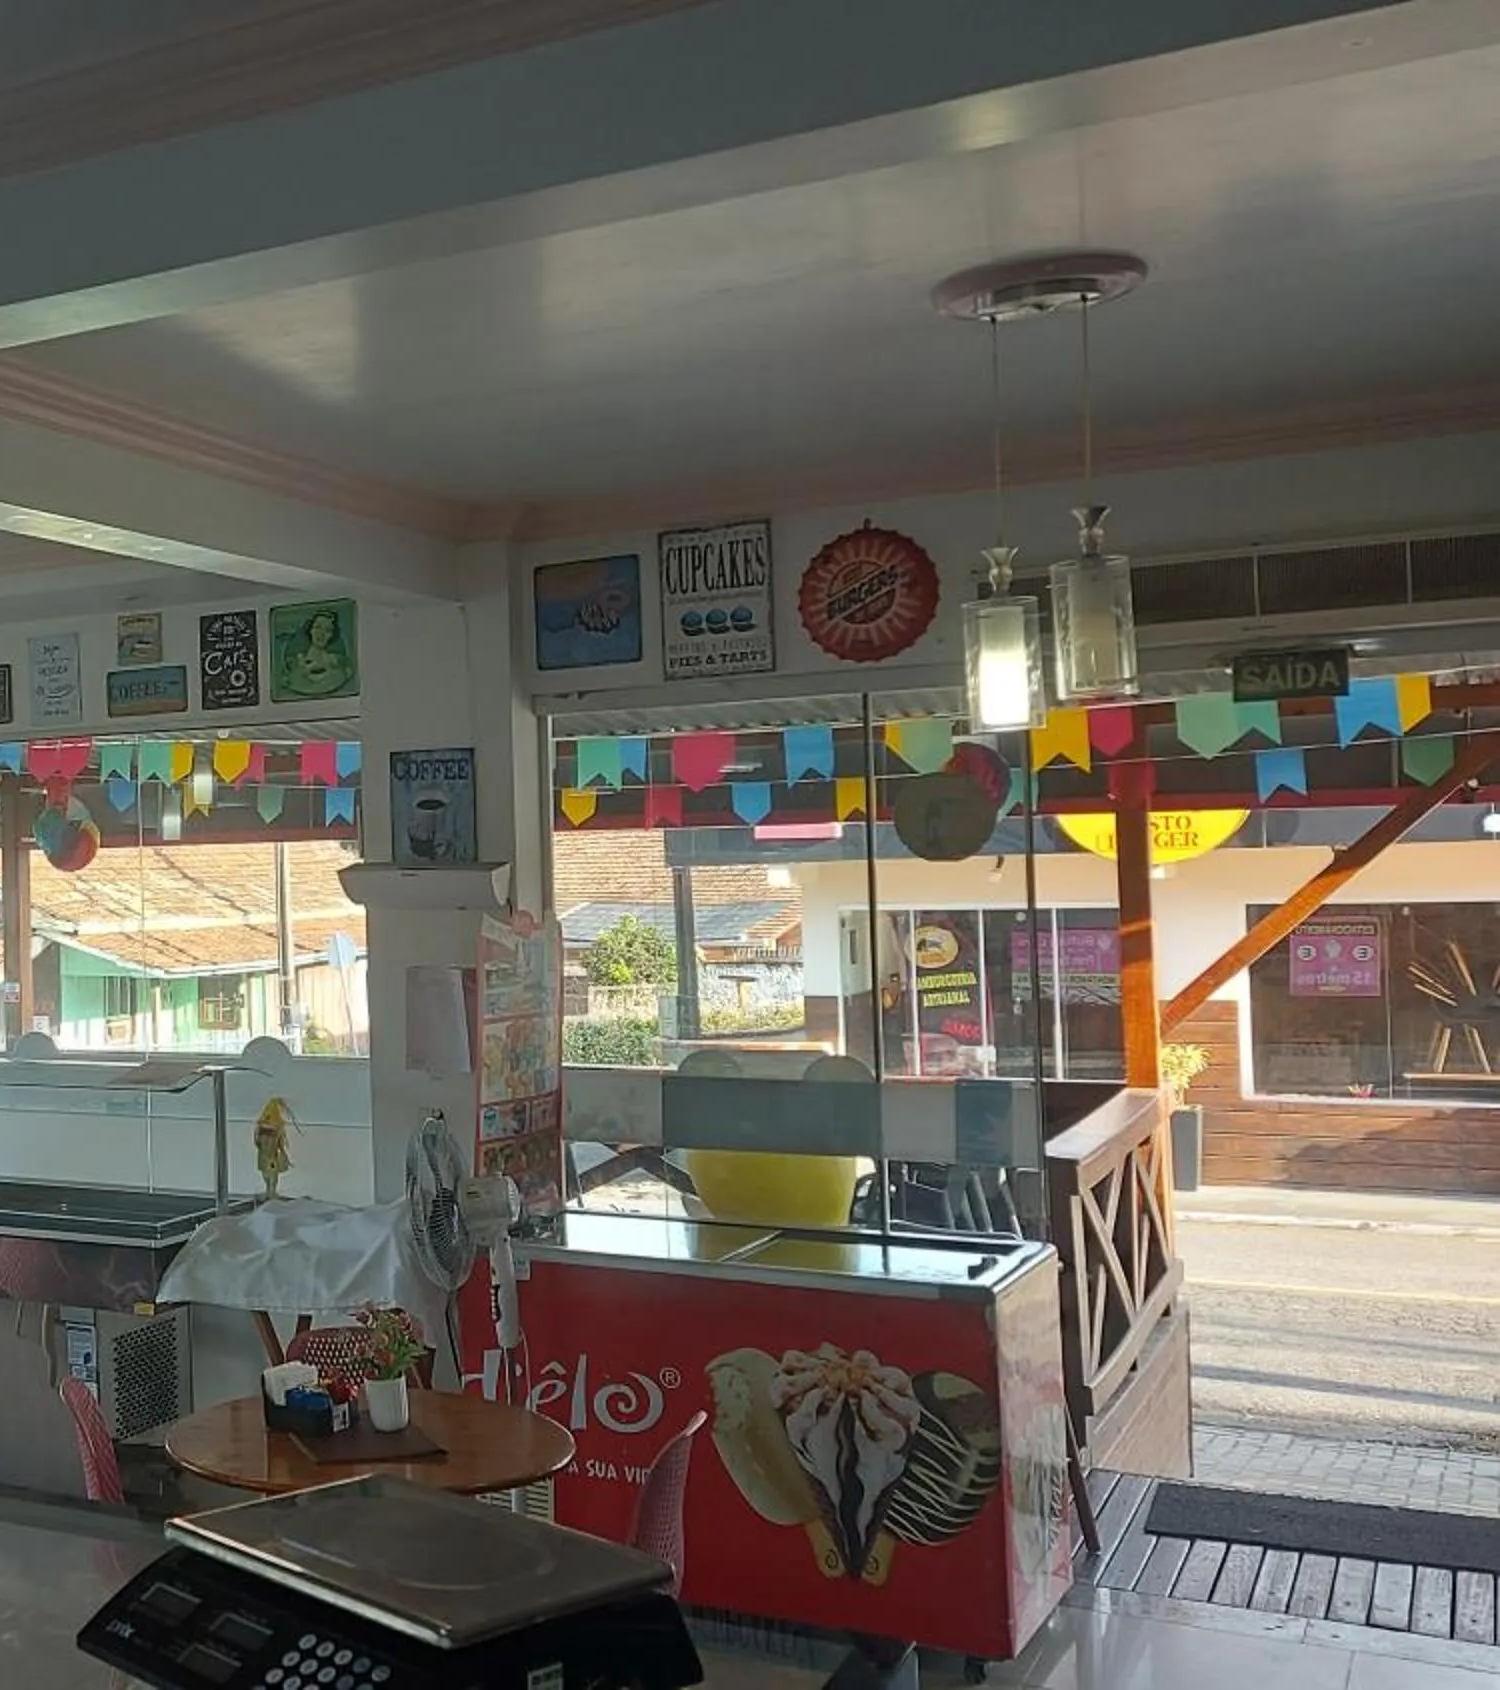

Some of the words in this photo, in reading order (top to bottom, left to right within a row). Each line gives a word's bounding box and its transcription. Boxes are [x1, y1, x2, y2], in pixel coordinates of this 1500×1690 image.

[665, 536, 766, 595] CUPCAKES
[668, 655, 702, 668] PIES
[706, 653, 717, 665] &
[719, 650, 768, 664] TARTS
[394, 757, 470, 781] COFFEE
[1149, 815, 1193, 832] STO
[1153, 831, 1199, 848] GER
[586, 1459, 617, 1480] SUA
